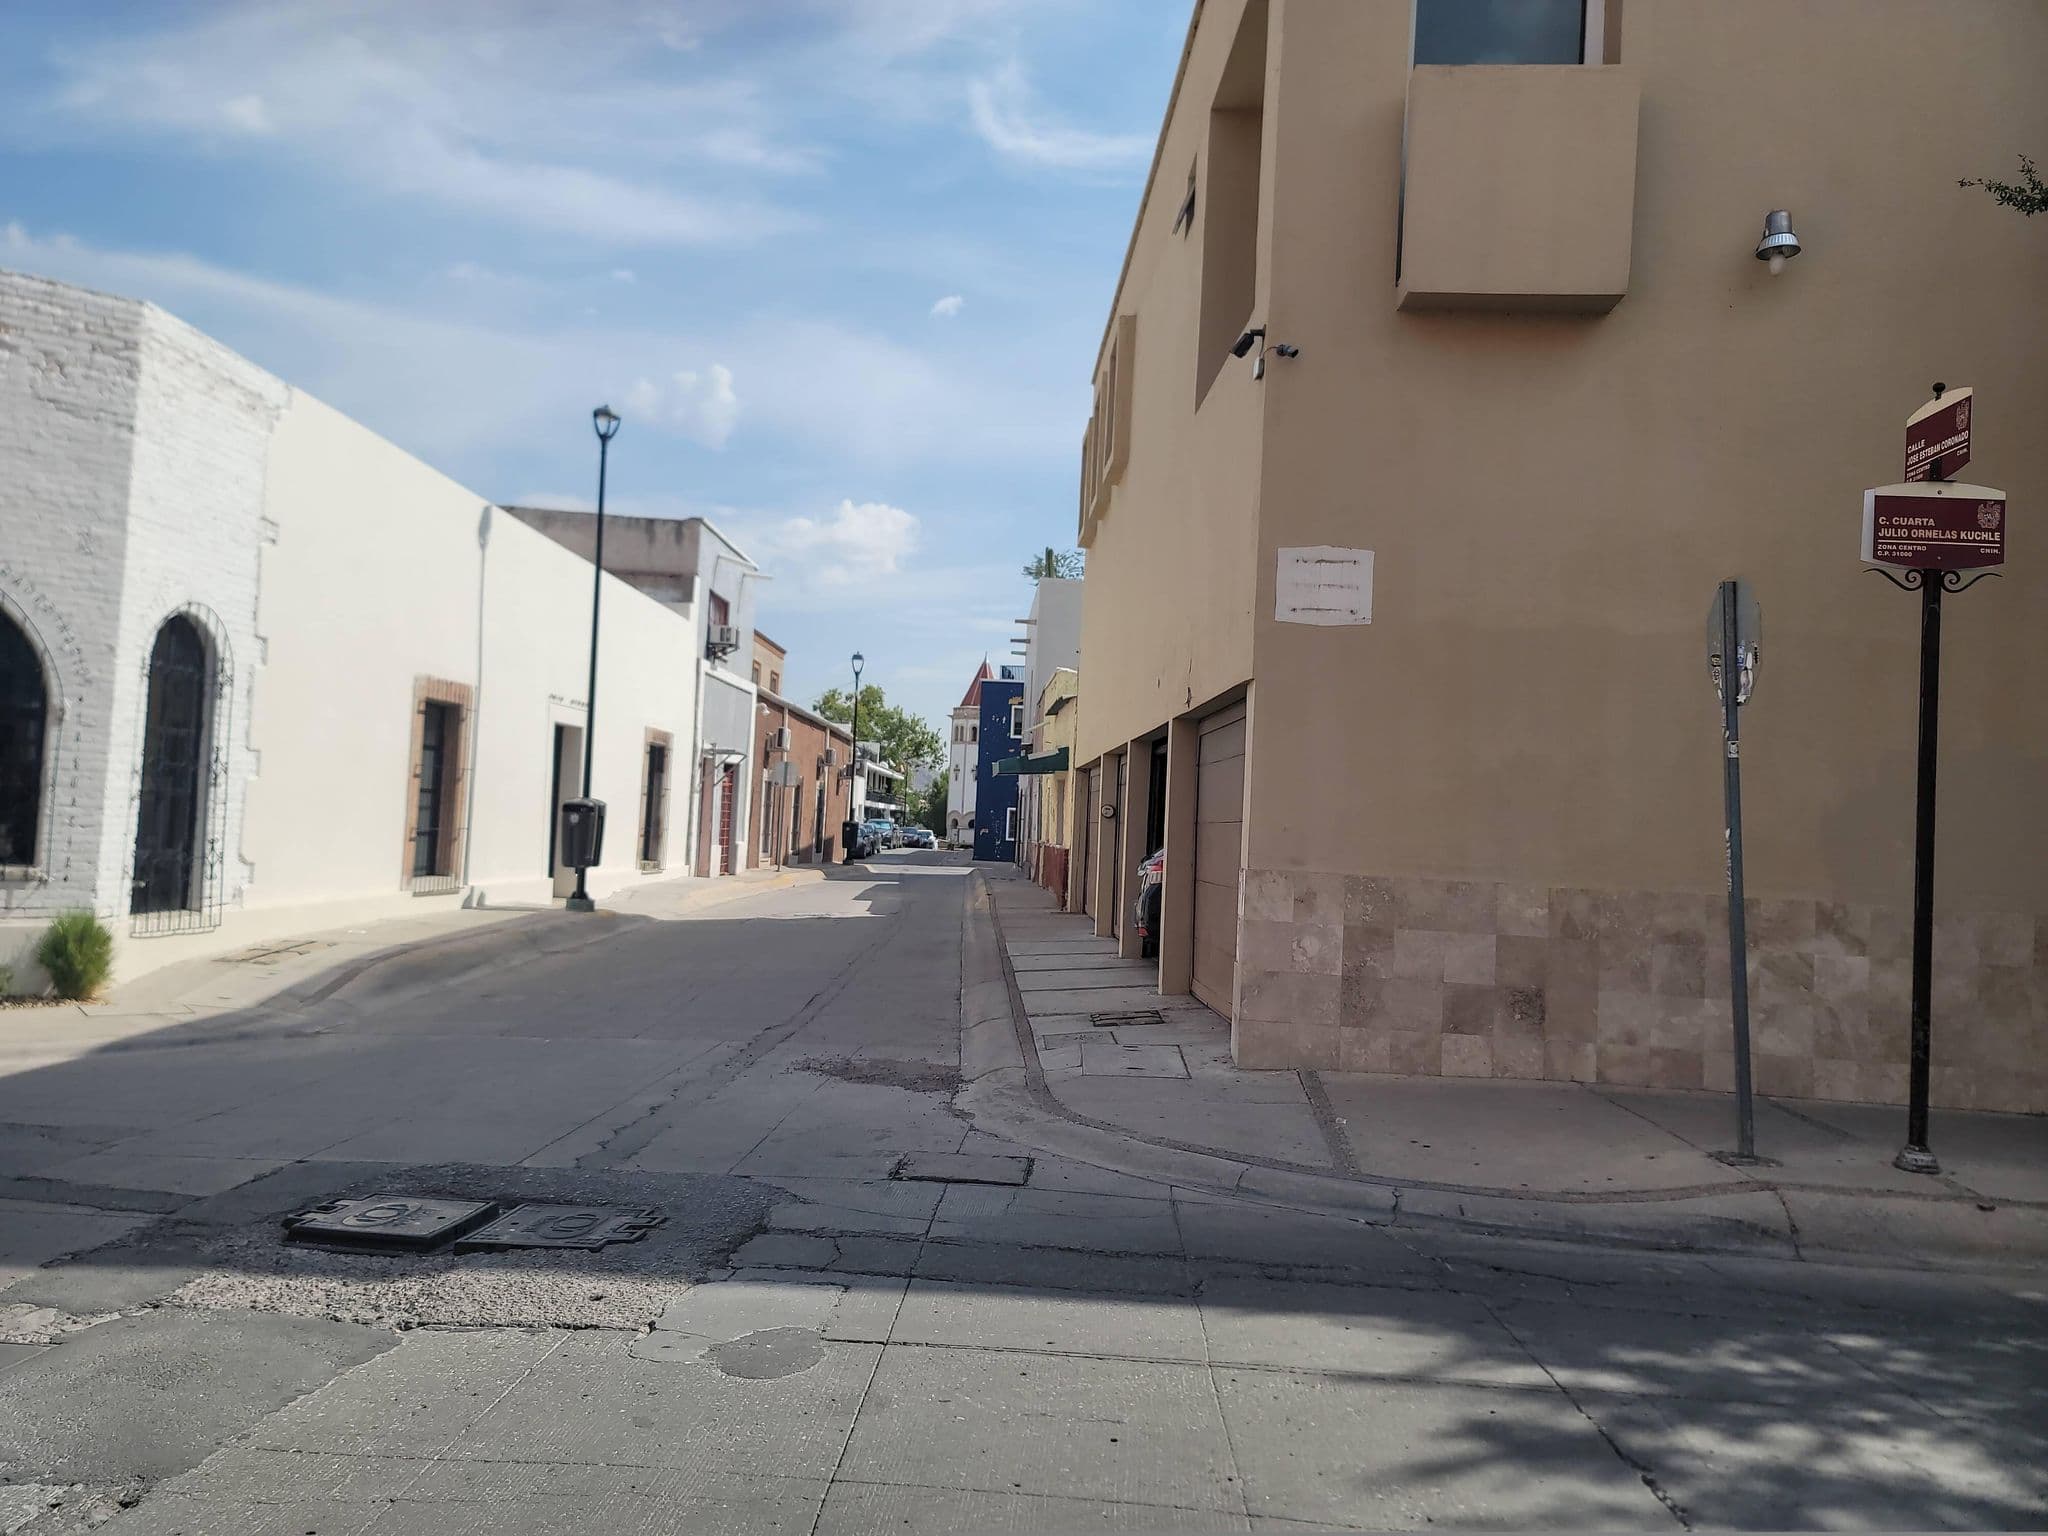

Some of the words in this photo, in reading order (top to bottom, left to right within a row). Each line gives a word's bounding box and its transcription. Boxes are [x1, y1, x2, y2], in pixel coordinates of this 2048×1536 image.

[1907, 439, 1926, 454] CALLE
[1907, 453, 1919, 466] JOSE
[1879, 516, 1890, 525] C.
[1892, 517, 1936, 527] CUARTA
[1878, 528, 1908, 538] JULIO
[1911, 529, 1958, 539] ORNELAS
[1960, 531, 2001, 541] KUCHLE
